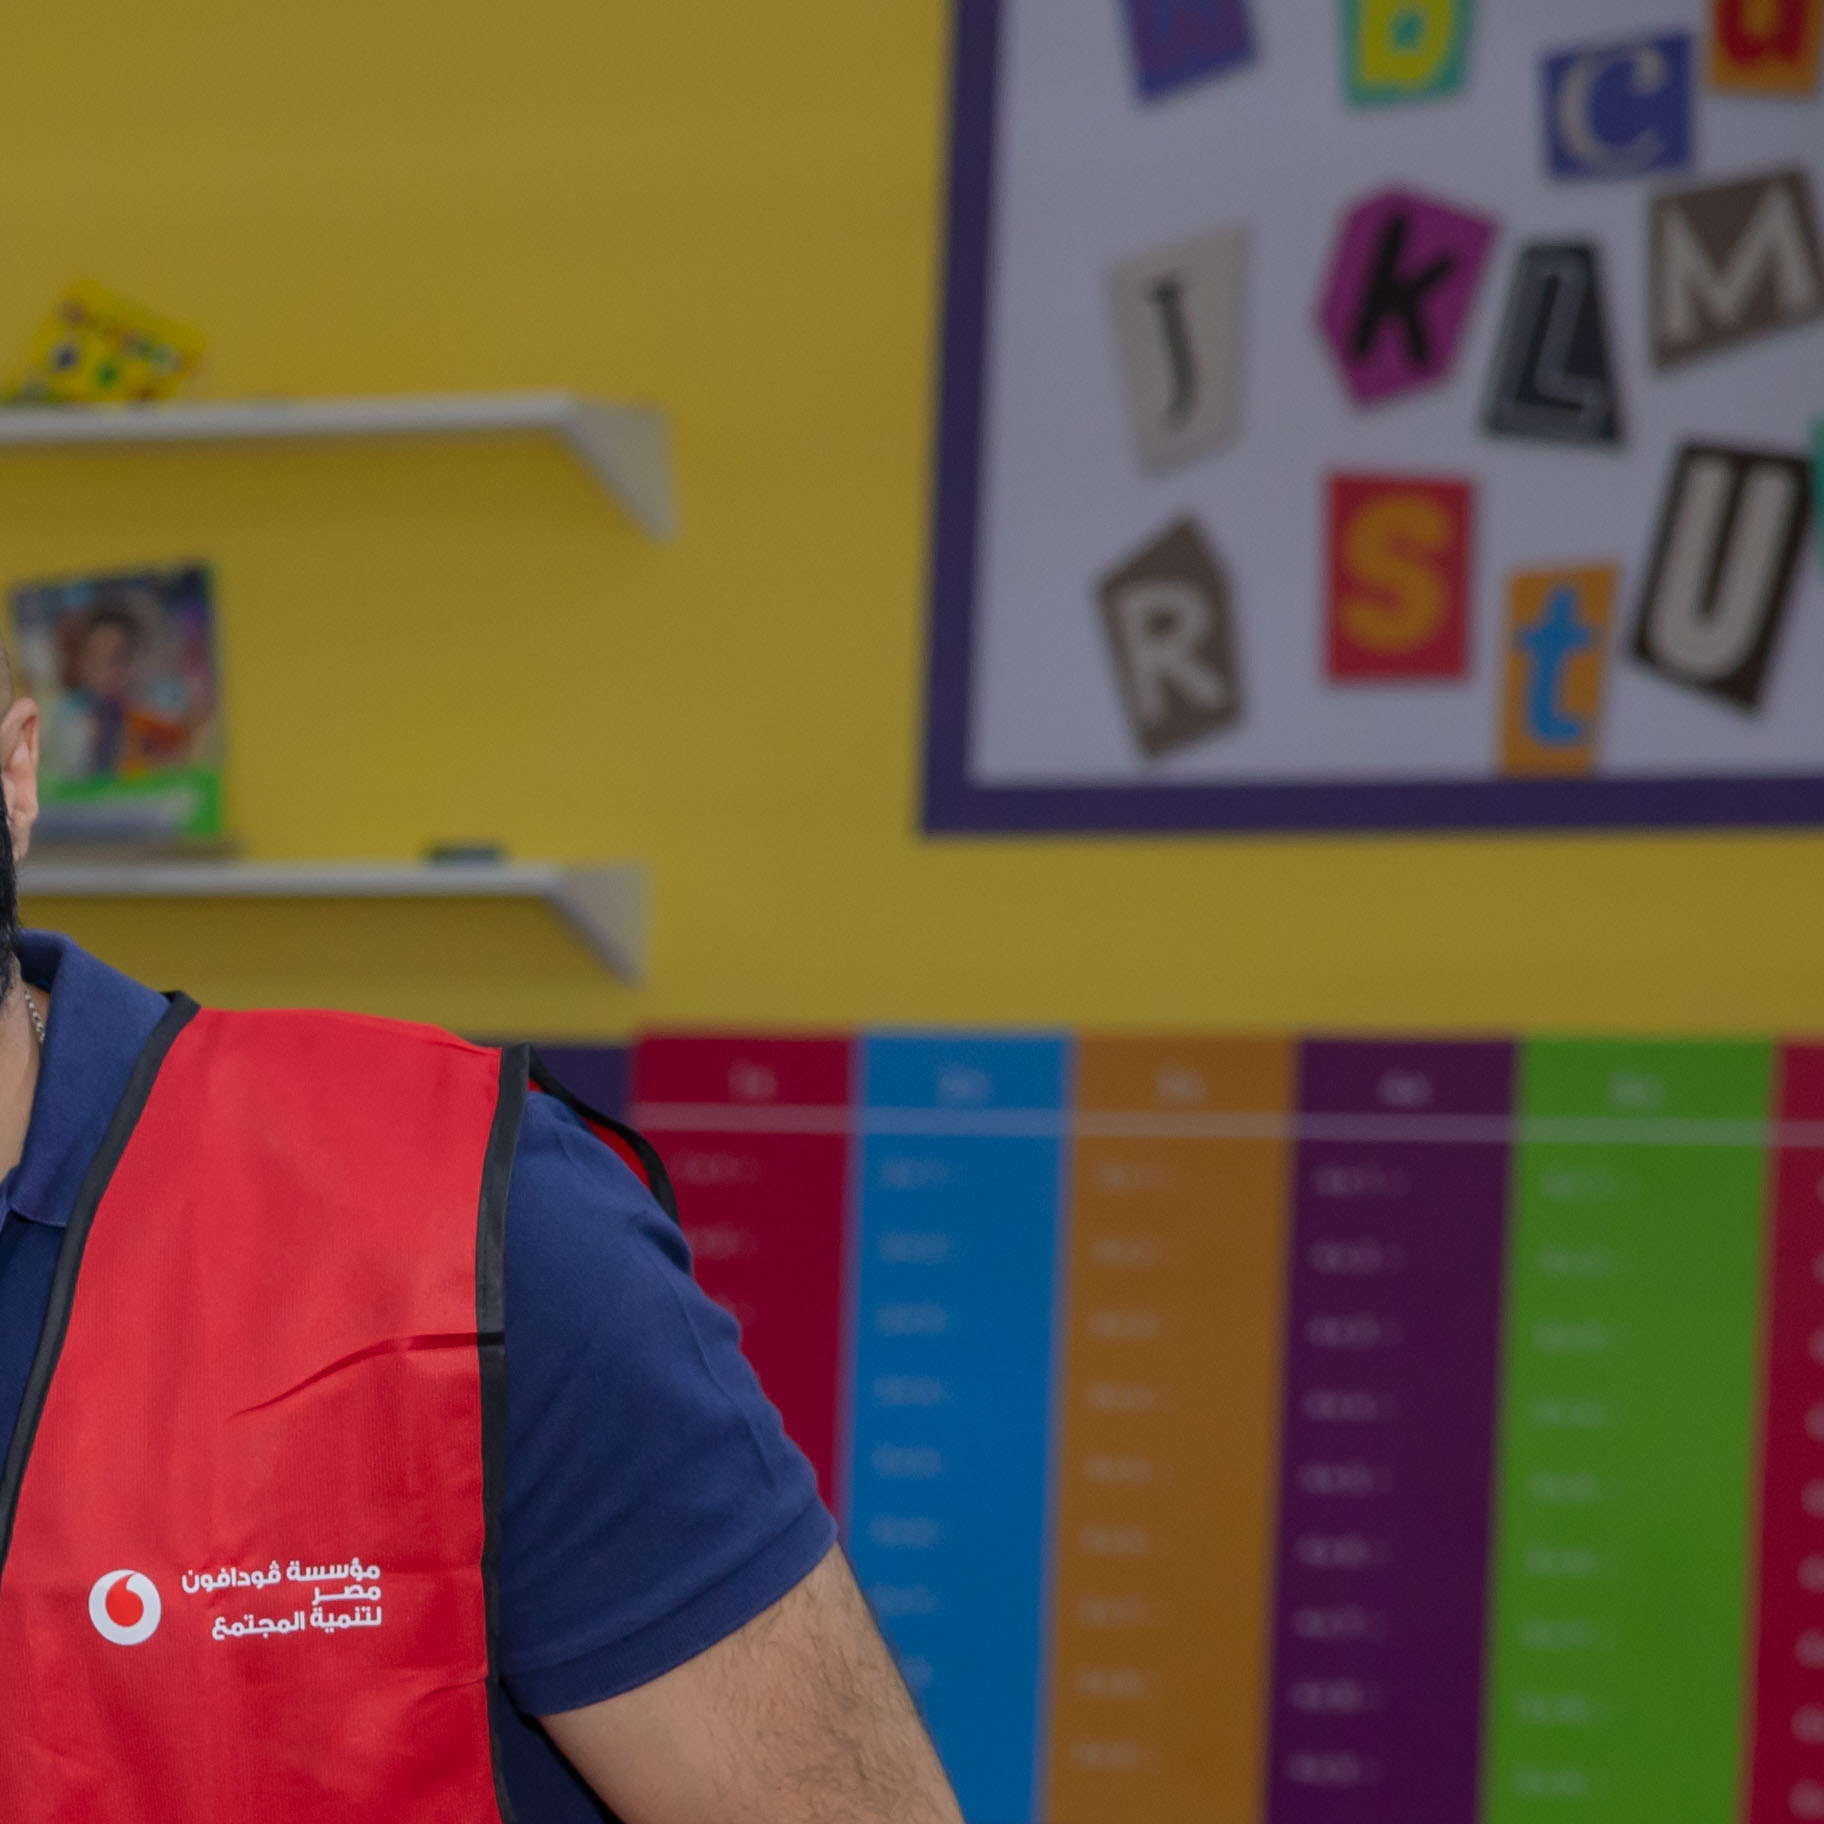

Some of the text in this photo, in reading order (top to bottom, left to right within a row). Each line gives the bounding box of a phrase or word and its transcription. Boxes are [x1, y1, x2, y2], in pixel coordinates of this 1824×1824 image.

[1657, 182, 1823, 341] M
[1117, 579, 1225, 724] R
[1640, 455, 1800, 681] U
[286, 1557, 381, 1582] مؤسسة
[312, 1584, 381, 1606] مصر
[212, 1606, 382, 1640] لتنمية المجتمع
